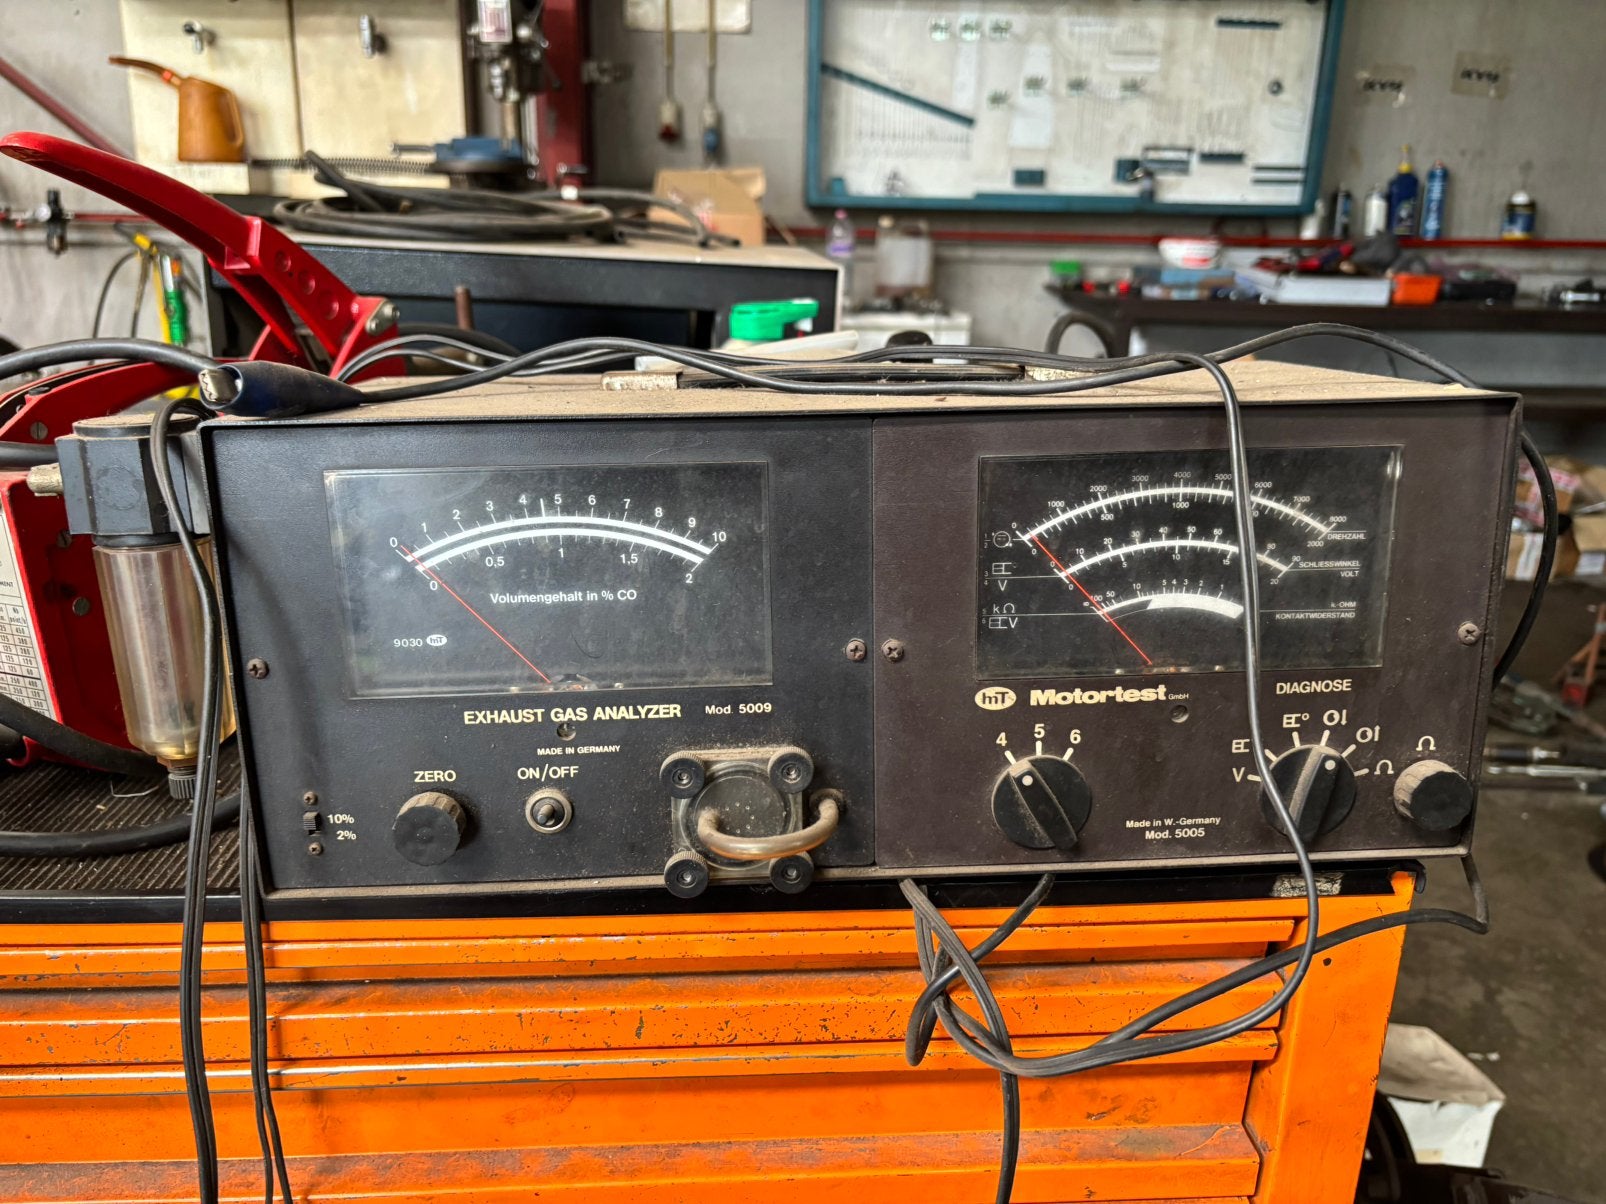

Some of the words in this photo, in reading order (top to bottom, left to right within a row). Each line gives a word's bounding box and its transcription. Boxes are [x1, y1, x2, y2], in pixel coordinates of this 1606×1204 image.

[1048, 500, 1065, 508] 1000
[389, 537, 398, 548] 0
[421, 522, 428, 533] 1
[452, 509, 461, 520] 2
[486, 501, 494, 512] 3
[519, 494, 528, 505] 4
[554, 494, 562, 505] 5
[588, 494, 596, 506] 6
[623, 498, 631, 510] 7
[654, 506, 663, 518] 8
[688, 517, 696, 528] 9
[712, 531, 727, 542] 10
[1132, 530, 1140, 538] 30
[1158, 526, 1168, 534] 40
[1214, 528, 1222, 536] 60
[1307, 540, 1324, 548] 2000
[1222, 558, 1230, 566] 15
[1299, 560, 1361, 568] SCHLIESSWINKEL
[430, 580, 438, 591] 0
[486, 556, 505, 568] 0,5
[558, 548, 564, 558] 1
[620, 554, 639, 566] 1,5
[686, 574, 694, 584] 2
[998, 580, 1008, 592] V
[490, 591, 583, 604] Volumengehalt
[586, 590, 598, 601] in
[601, 590, 614, 600] %
[617, 590, 638, 600] CO
[393, 638, 423, 648] 9030
[1276, 679, 1353, 695] DIAGNOSE
[1030, 684, 1167, 706] Motortest
[1168, 692, 1190, 700] GmbH
[464, 709, 545, 724] EXHAUST
[550, 707, 588, 723] GAS
[593, 704, 682, 721] ANALYZER
[705, 704, 734, 715] Mod.
[738, 702, 772, 714] 5009
[1034, 724, 1046, 738] 5
[1070, 729, 1082, 744] 6
[996, 732, 1008, 746] 4
[537, 747, 563, 756] MADE
[565, 746, 575, 754] IN
[577, 745, 621, 755] GERMANY
[414, 770, 456, 782] ZERO
[517, 764, 580, 782] ON/OFF
[1232, 767, 1246, 783] V
[328, 814, 354, 824] 10%
[1126, 820, 1152, 828] Made
[1152, 818, 1162, 826] in
[1164, 816, 1221, 826] W.-Germany
[336, 830, 356, 840] 2%
[1145, 830, 1172, 840] Mod.
[1174, 828, 1206, 838] 5005
